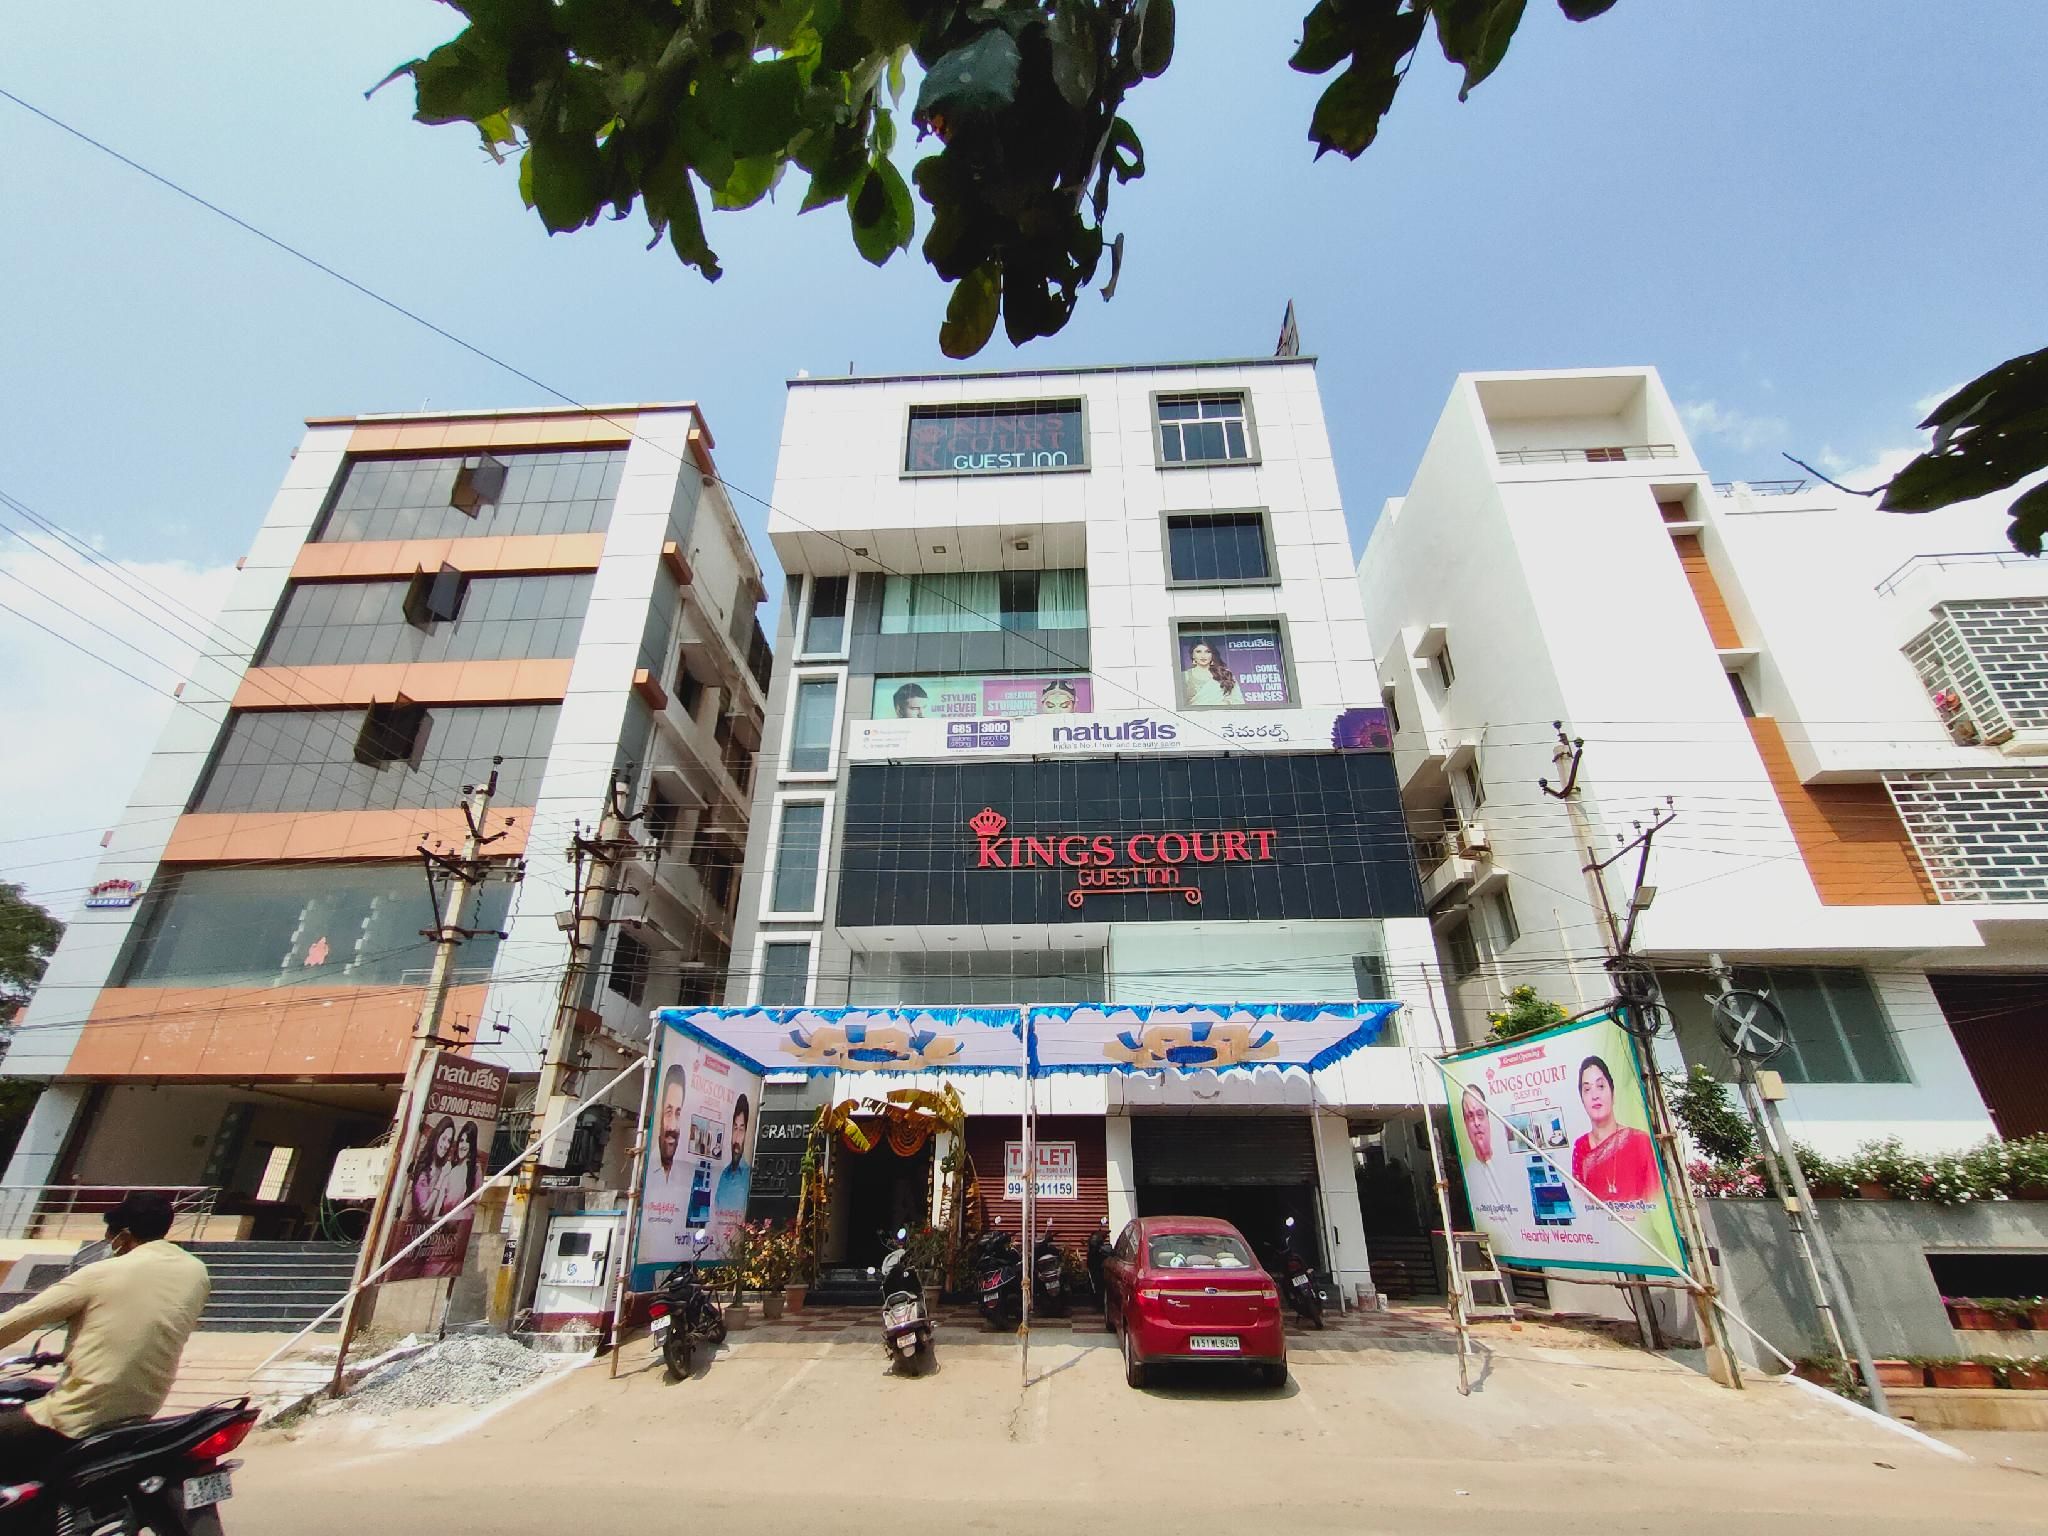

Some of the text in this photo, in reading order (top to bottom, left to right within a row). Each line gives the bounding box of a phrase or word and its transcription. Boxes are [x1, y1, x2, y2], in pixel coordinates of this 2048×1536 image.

[954, 413, 1063, 437] KINGS
[947, 431, 1065, 453] COURT
[953, 452, 1026, 470] GUEST
[1228, 638, 1275, 649] naturals
[1240, 673, 1281, 684] PAMPER
[1261, 683, 1282, 691] YOUR
[941, 693, 976, 702] STYLING
[1245, 691, 1284, 702] SENSES
[946, 703, 977, 712] NEVER
[987, 700, 1037, 711] STUNNING
[951, 724, 972, 733] 685
[981, 722, 1008, 733] 3000
[1052, 718, 1177, 742] naturals
[1133, 741, 1158, 749] beauty
[977, 830, 1278, 868] KINGS COURT
[1078, 869, 1139, 886] GUEST
[436, 1064, 501, 1091] naturals
[1489, 1065, 1567, 1095] KINGS COURT
[439, 1095, 468, 1114] 97000
